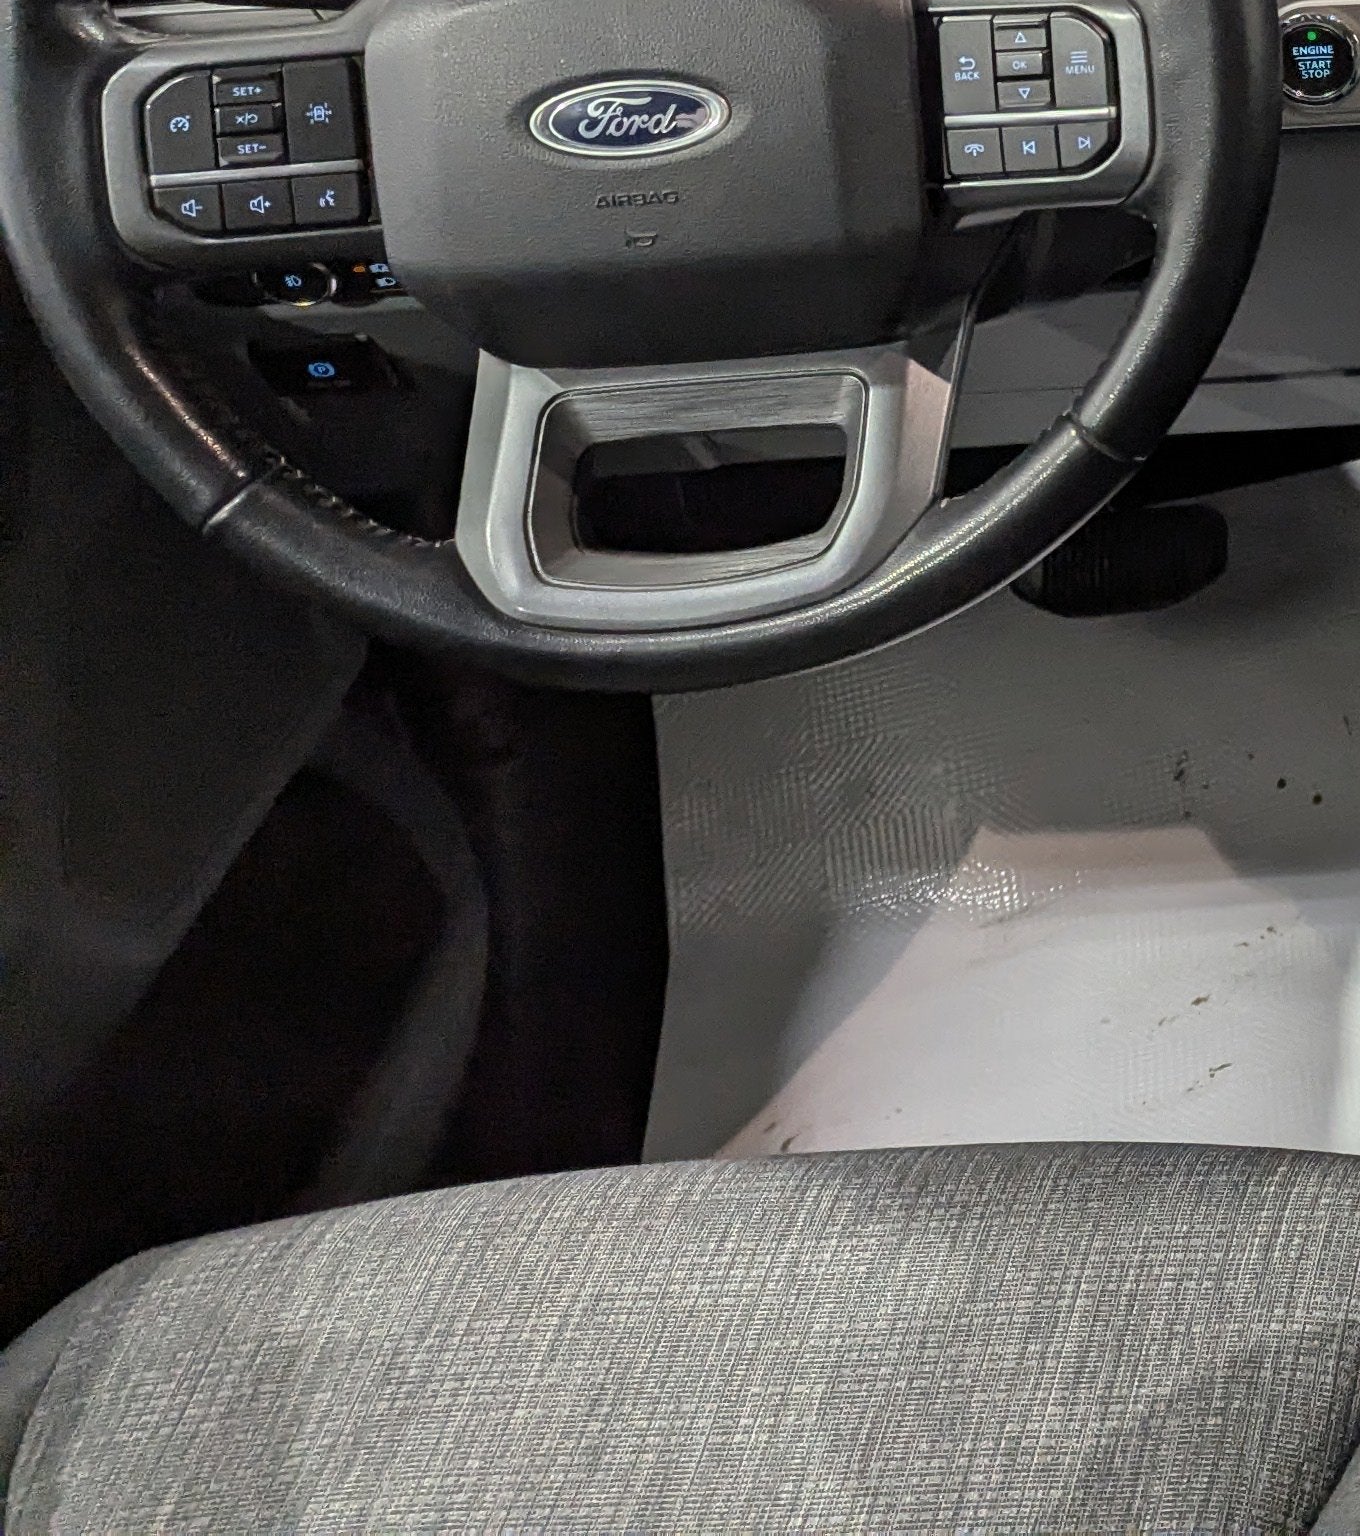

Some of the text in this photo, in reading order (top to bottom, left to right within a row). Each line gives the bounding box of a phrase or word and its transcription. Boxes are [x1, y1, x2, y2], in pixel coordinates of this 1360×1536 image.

[1291, 44, 1335, 57] ENGINE
[1012, 59, 1028, 70] OK
[1064, 65, 1096, 76] MENU
[1297, 59, 1333, 71] START
[953, 70, 981, 82] BACK
[1301, 68, 1331, 80] STOP
[577, 96, 678, 140] Ford
[595, 190, 680, 210] AIRBAG
